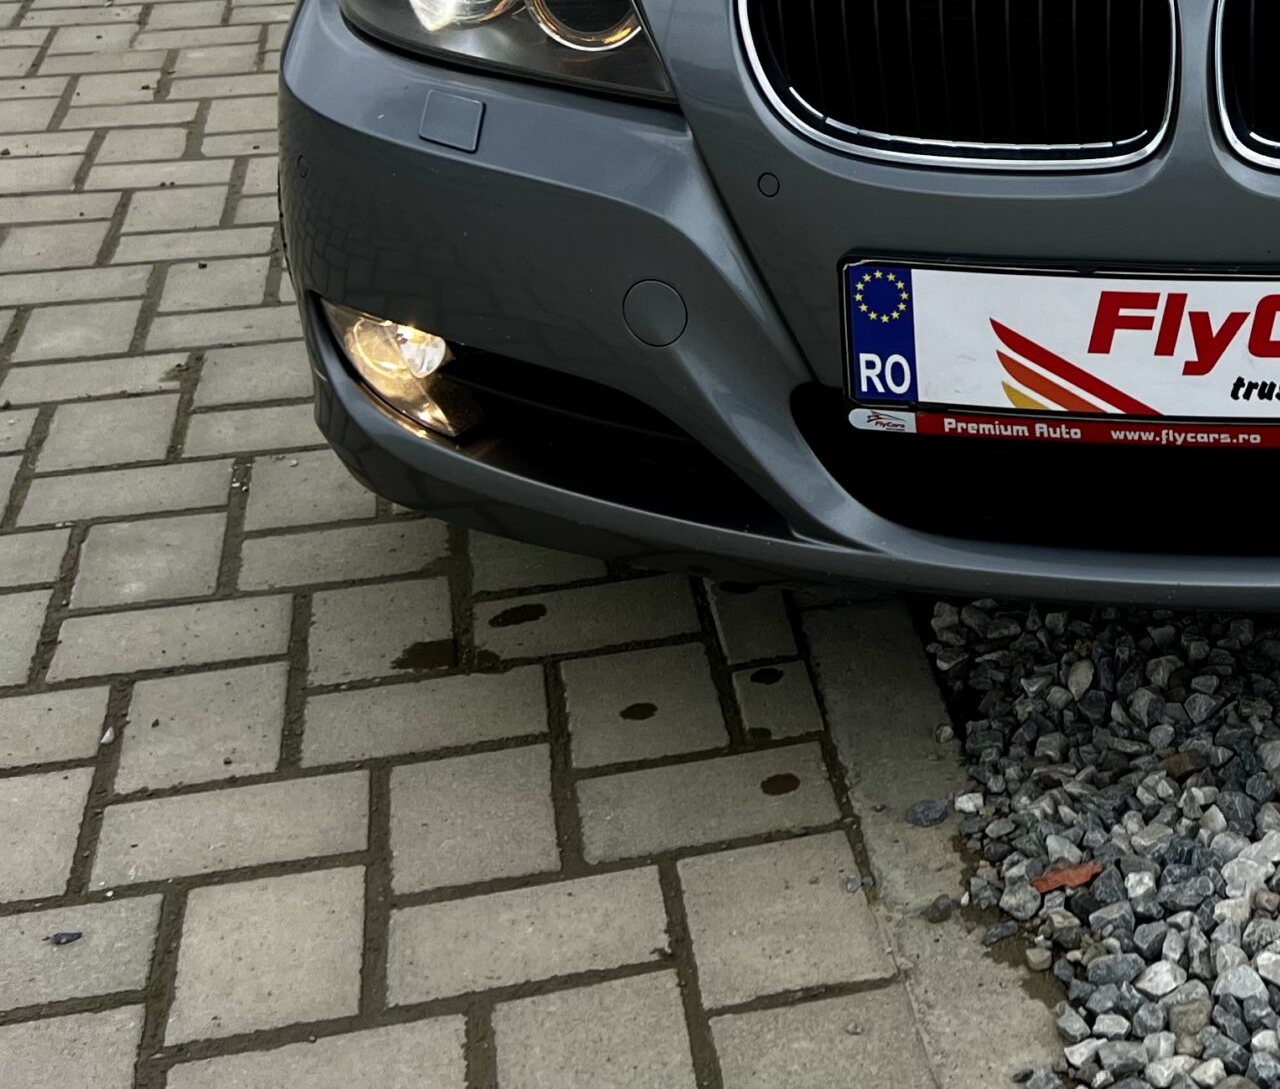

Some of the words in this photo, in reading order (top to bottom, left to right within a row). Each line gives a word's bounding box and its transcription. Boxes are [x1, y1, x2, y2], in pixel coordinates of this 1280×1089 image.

[859, 352, 911, 395] RO
[944, 418, 1029, 438] Premium
[1035, 423, 1082, 440] Auto
[1111, 428, 1262, 445] www.flycars.ro
